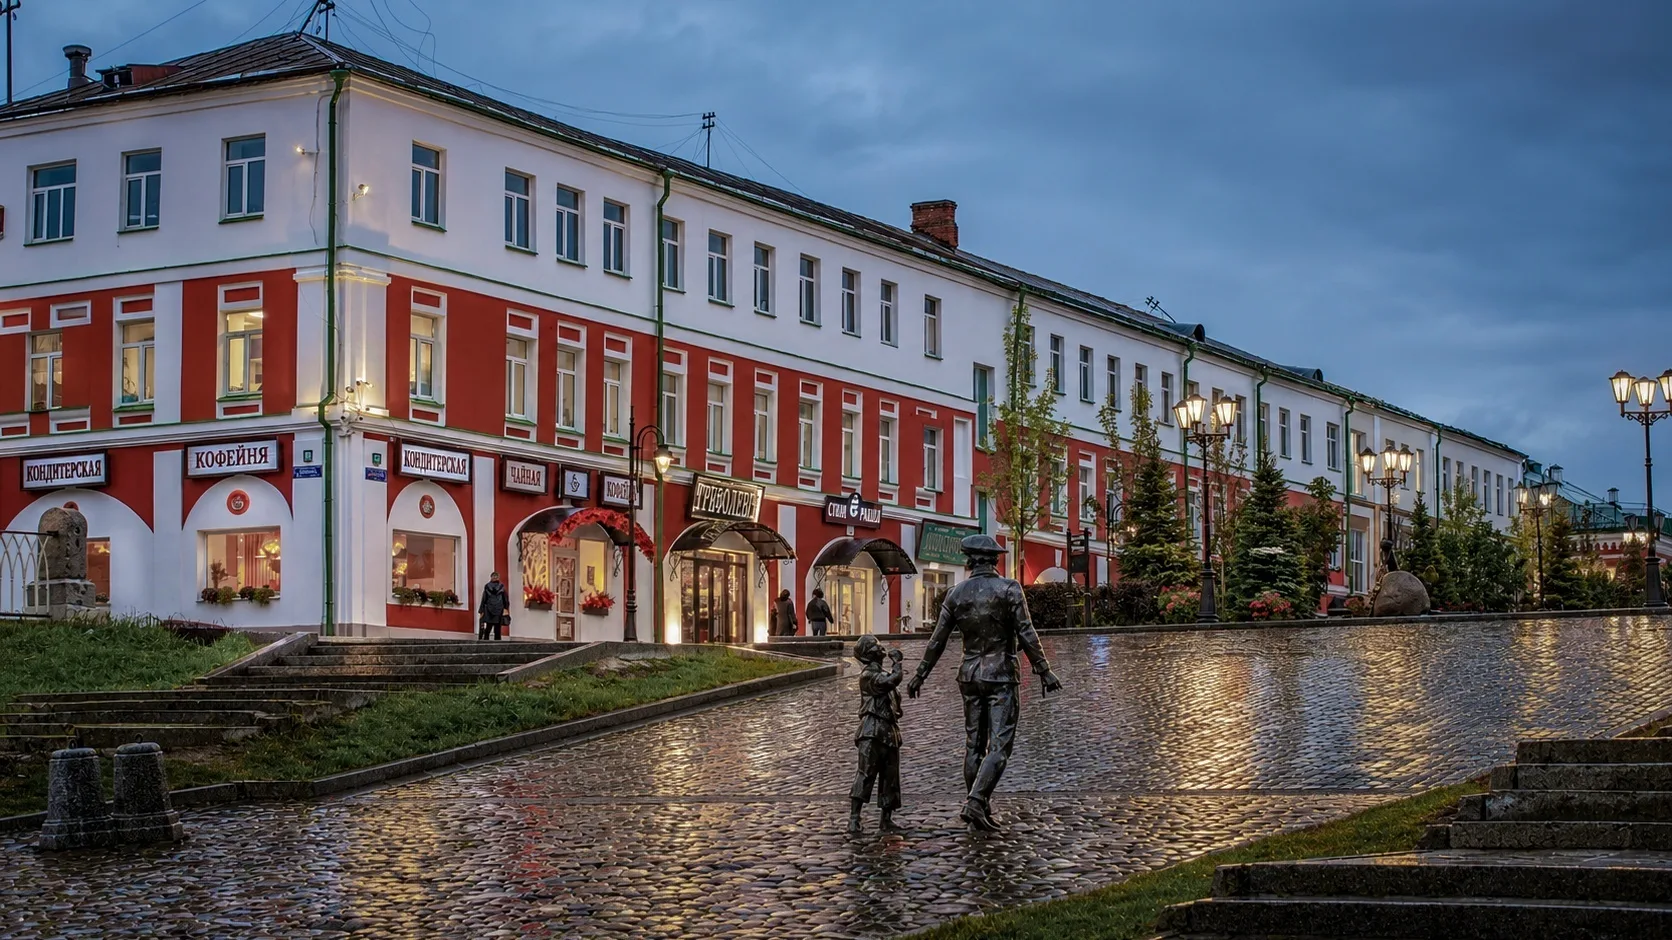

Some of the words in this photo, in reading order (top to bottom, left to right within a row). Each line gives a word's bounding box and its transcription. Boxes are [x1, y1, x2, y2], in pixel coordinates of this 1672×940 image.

[195, 445, 269, 469] КОФЕЙНЯ
[403, 450, 467, 475] КОНДИТЕРСКАЯ
[26, 460, 102, 483] КОНДИТЕРСКАЯ
[510, 466, 541, 487] ЧАЙНАЯ
